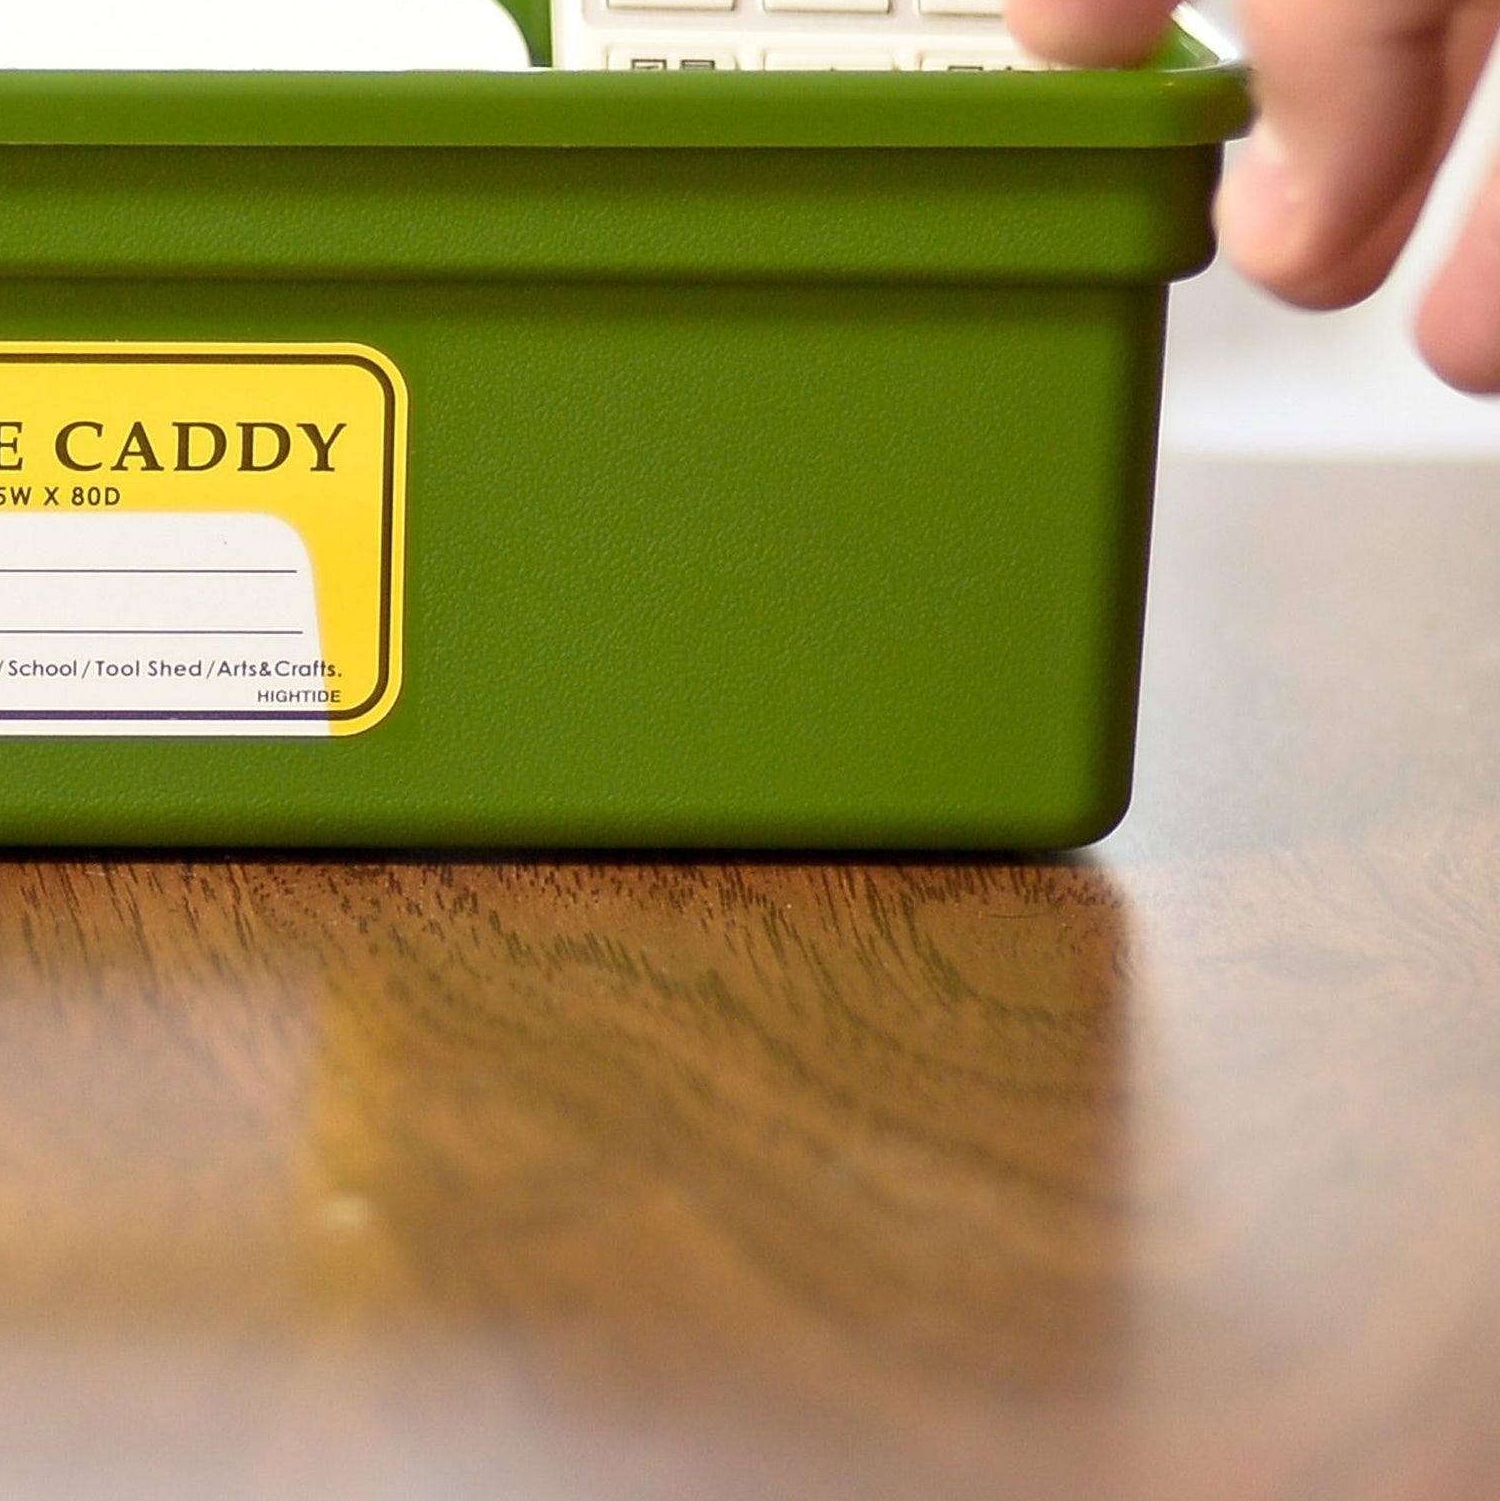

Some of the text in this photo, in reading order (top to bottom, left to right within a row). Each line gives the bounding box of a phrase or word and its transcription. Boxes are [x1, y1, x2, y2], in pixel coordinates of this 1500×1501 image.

[54, 421, 347, 472] CADDY
[43, 486, 60, 506] X
[71, 486, 121, 506] 80D
[257, 689, 341, 704] HIGHTIDE
